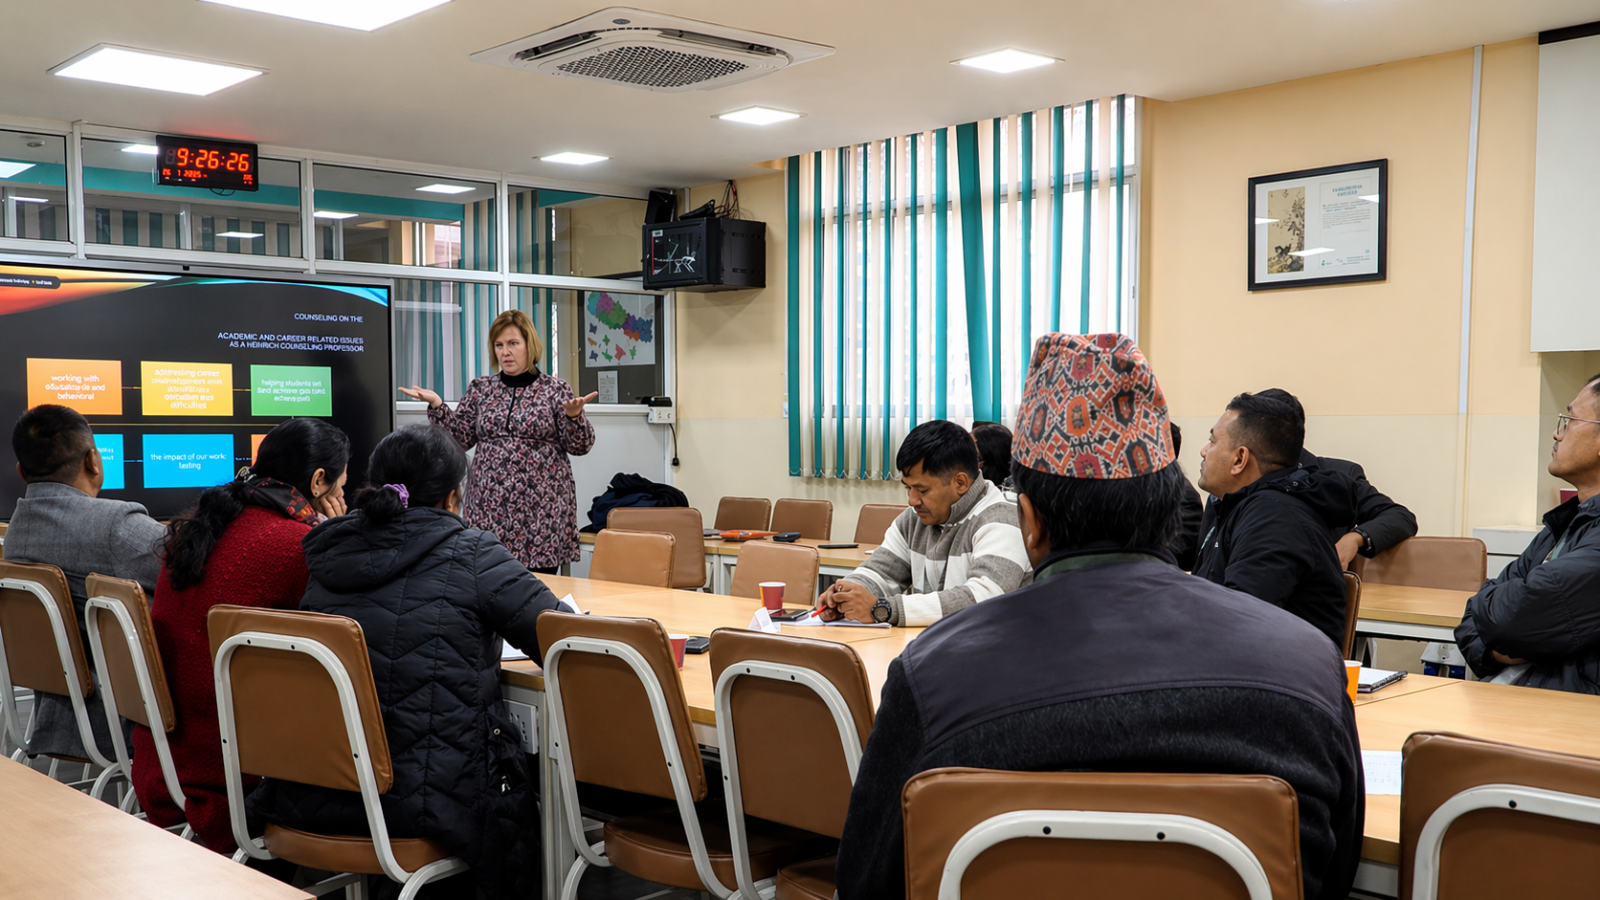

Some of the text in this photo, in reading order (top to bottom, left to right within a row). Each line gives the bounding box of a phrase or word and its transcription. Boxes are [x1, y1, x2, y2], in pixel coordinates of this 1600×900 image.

[177, 147, 250, 172] 9:26:26
[294, 313, 338, 322] COUNSELING
[218, 332, 258, 341] ACADEMIC
[259, 333, 276, 341] AND
[307, 336, 339, 344] RELATED
